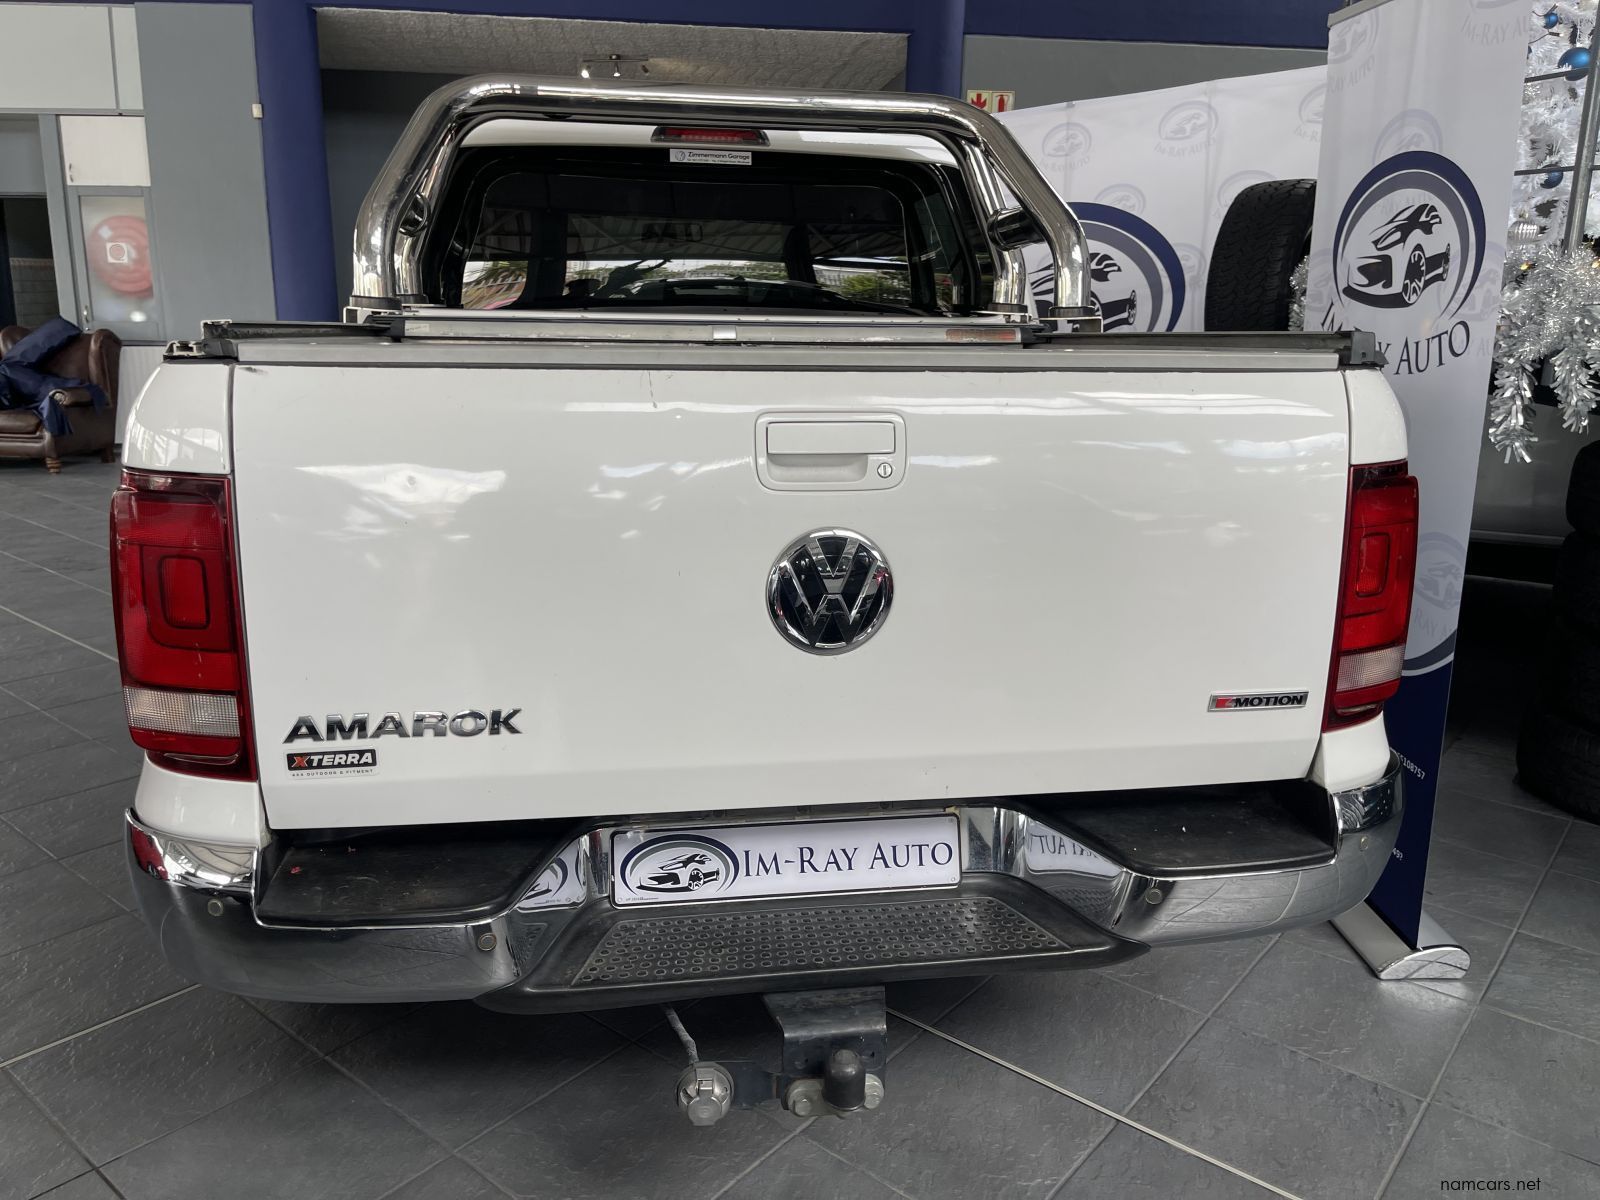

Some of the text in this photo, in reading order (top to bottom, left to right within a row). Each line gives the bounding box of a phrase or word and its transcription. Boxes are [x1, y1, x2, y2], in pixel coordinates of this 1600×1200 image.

[1393, 319, 1470, 375] AUTO
[282, 708, 523, 745] AMAROK
[291, 752, 374, 768] XTERRA
[742, 840, 954, 878] IM-RAY AUTO
